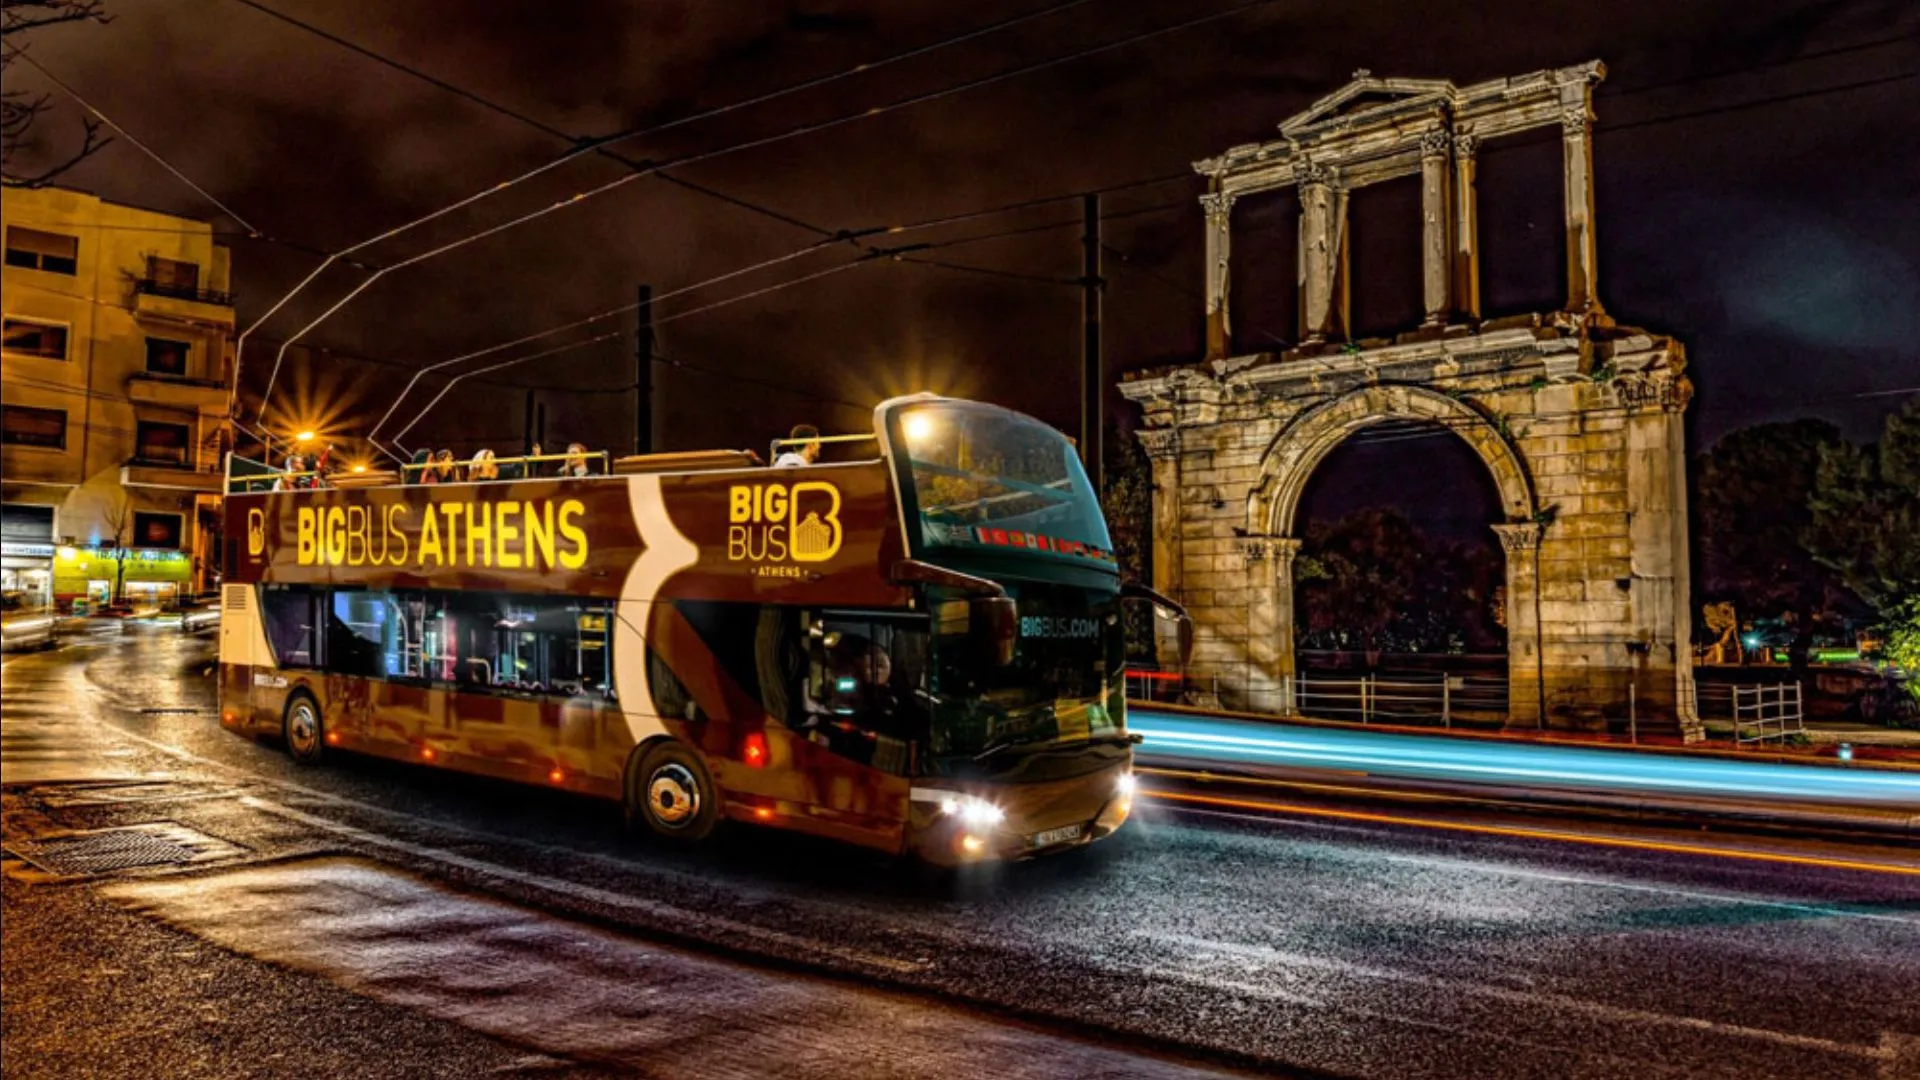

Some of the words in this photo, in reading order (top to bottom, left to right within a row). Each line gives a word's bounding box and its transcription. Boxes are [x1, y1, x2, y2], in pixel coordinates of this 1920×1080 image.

[730, 484, 788, 523] BIG
[417, 499, 588, 569] ATHENS
[728, 525, 787, 562] BUS
[758, 566, 801, 578] ATHENS
[1021, 616, 1100, 638] BIGBUS.COM
